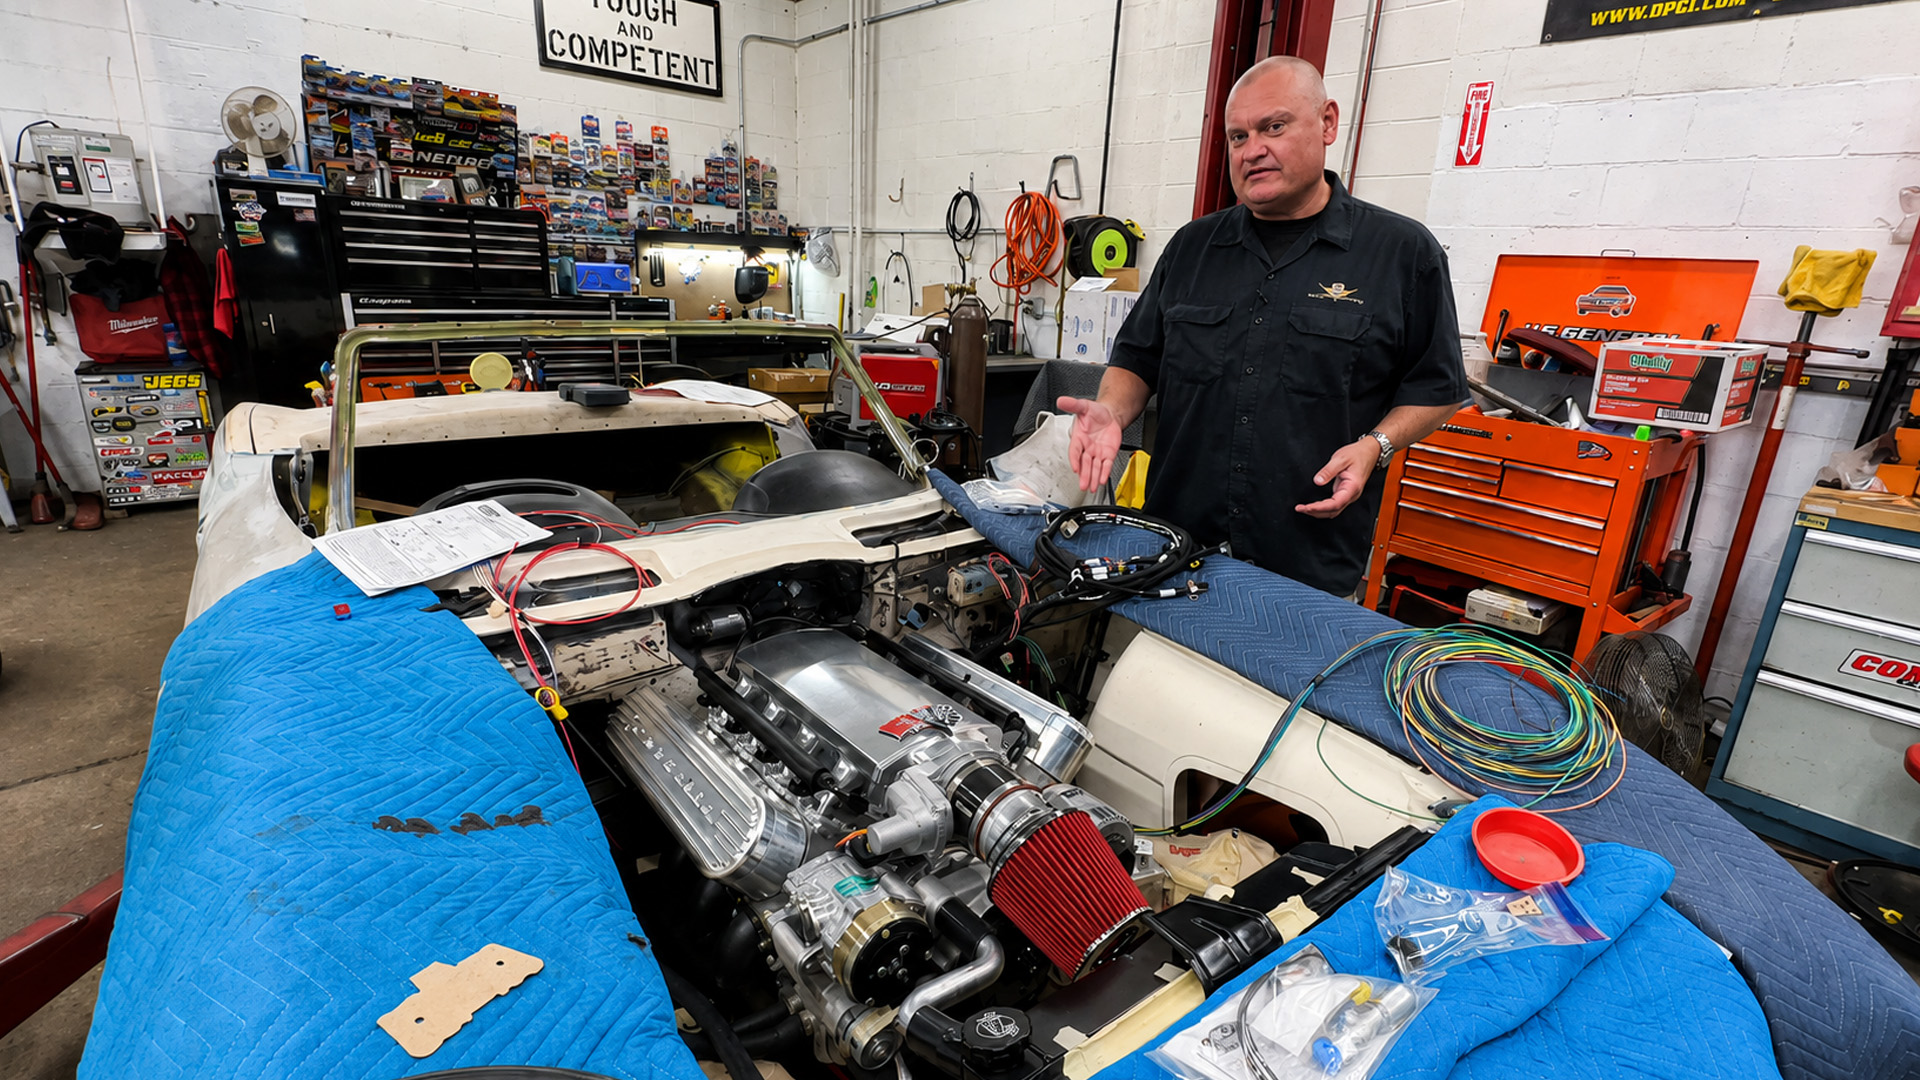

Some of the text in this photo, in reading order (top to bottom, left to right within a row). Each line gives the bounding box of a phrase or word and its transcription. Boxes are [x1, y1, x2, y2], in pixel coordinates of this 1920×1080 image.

[617, 21, 654, 42] AND
[548, 29, 714, 85] COMPETENT
[143, 374, 202, 390] JEGS
